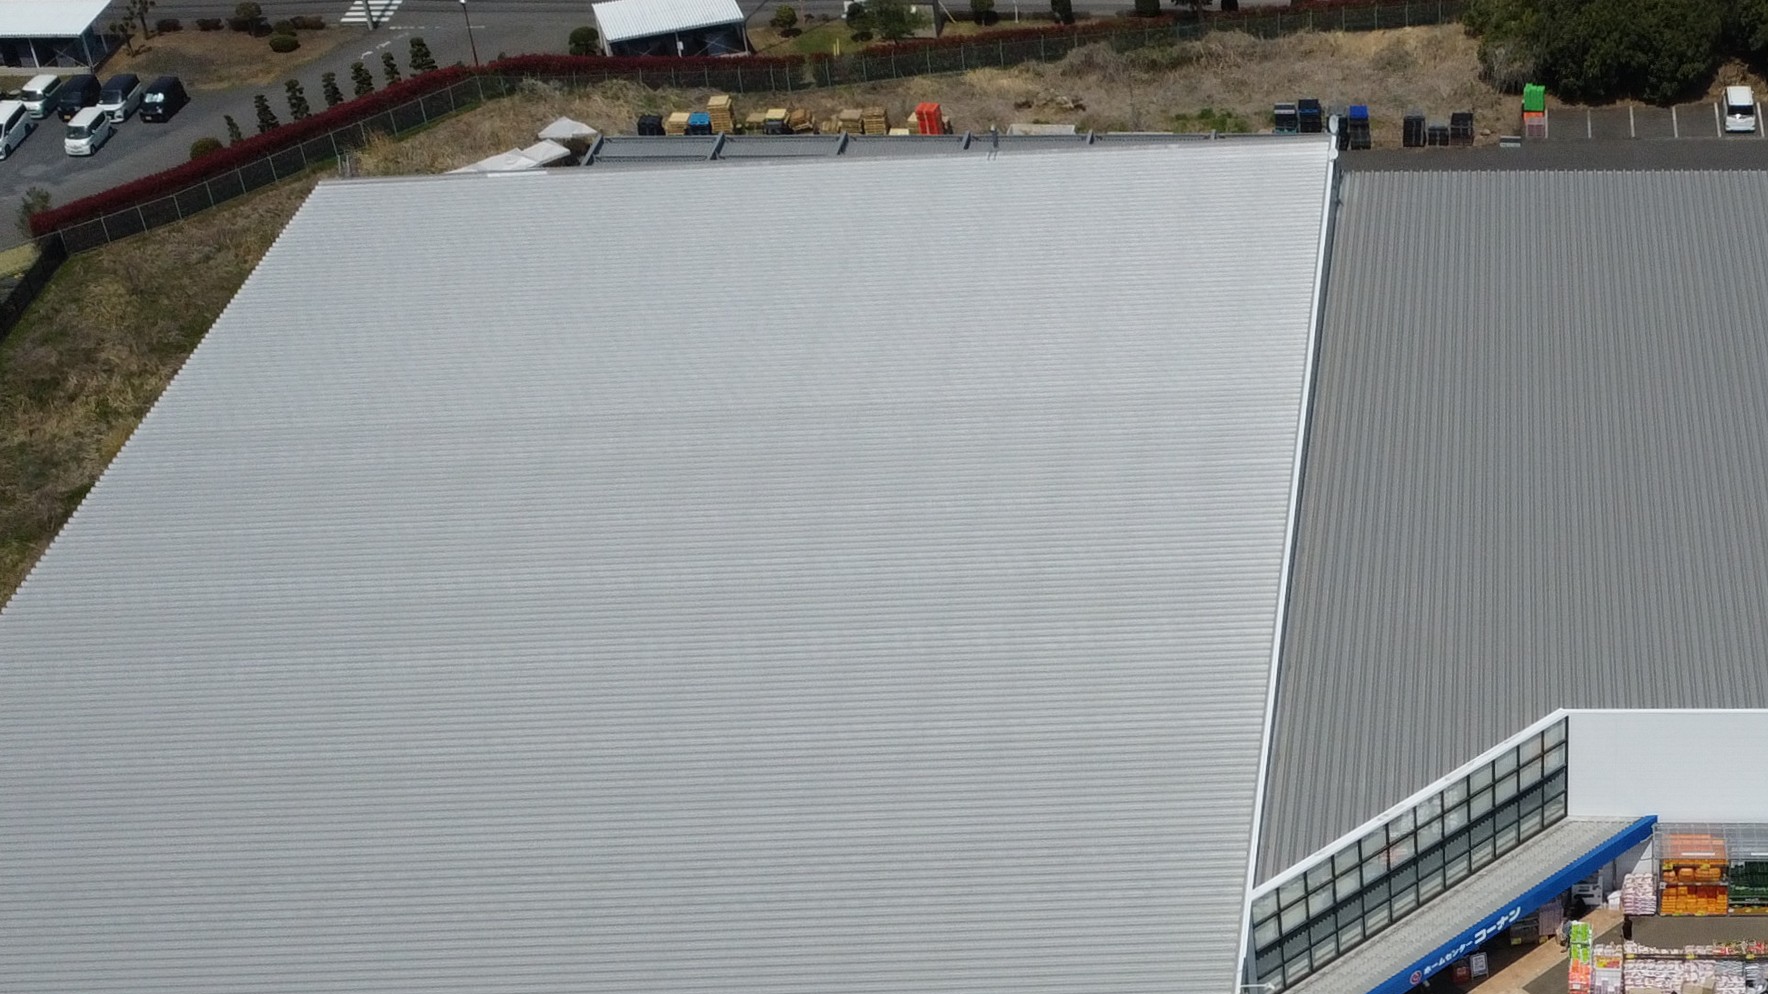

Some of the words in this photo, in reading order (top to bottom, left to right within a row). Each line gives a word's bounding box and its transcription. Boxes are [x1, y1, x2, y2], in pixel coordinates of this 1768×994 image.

[1423, 940, 1473, 975] ホームセンター
[1474, 906, 1521, 945] コーナン
